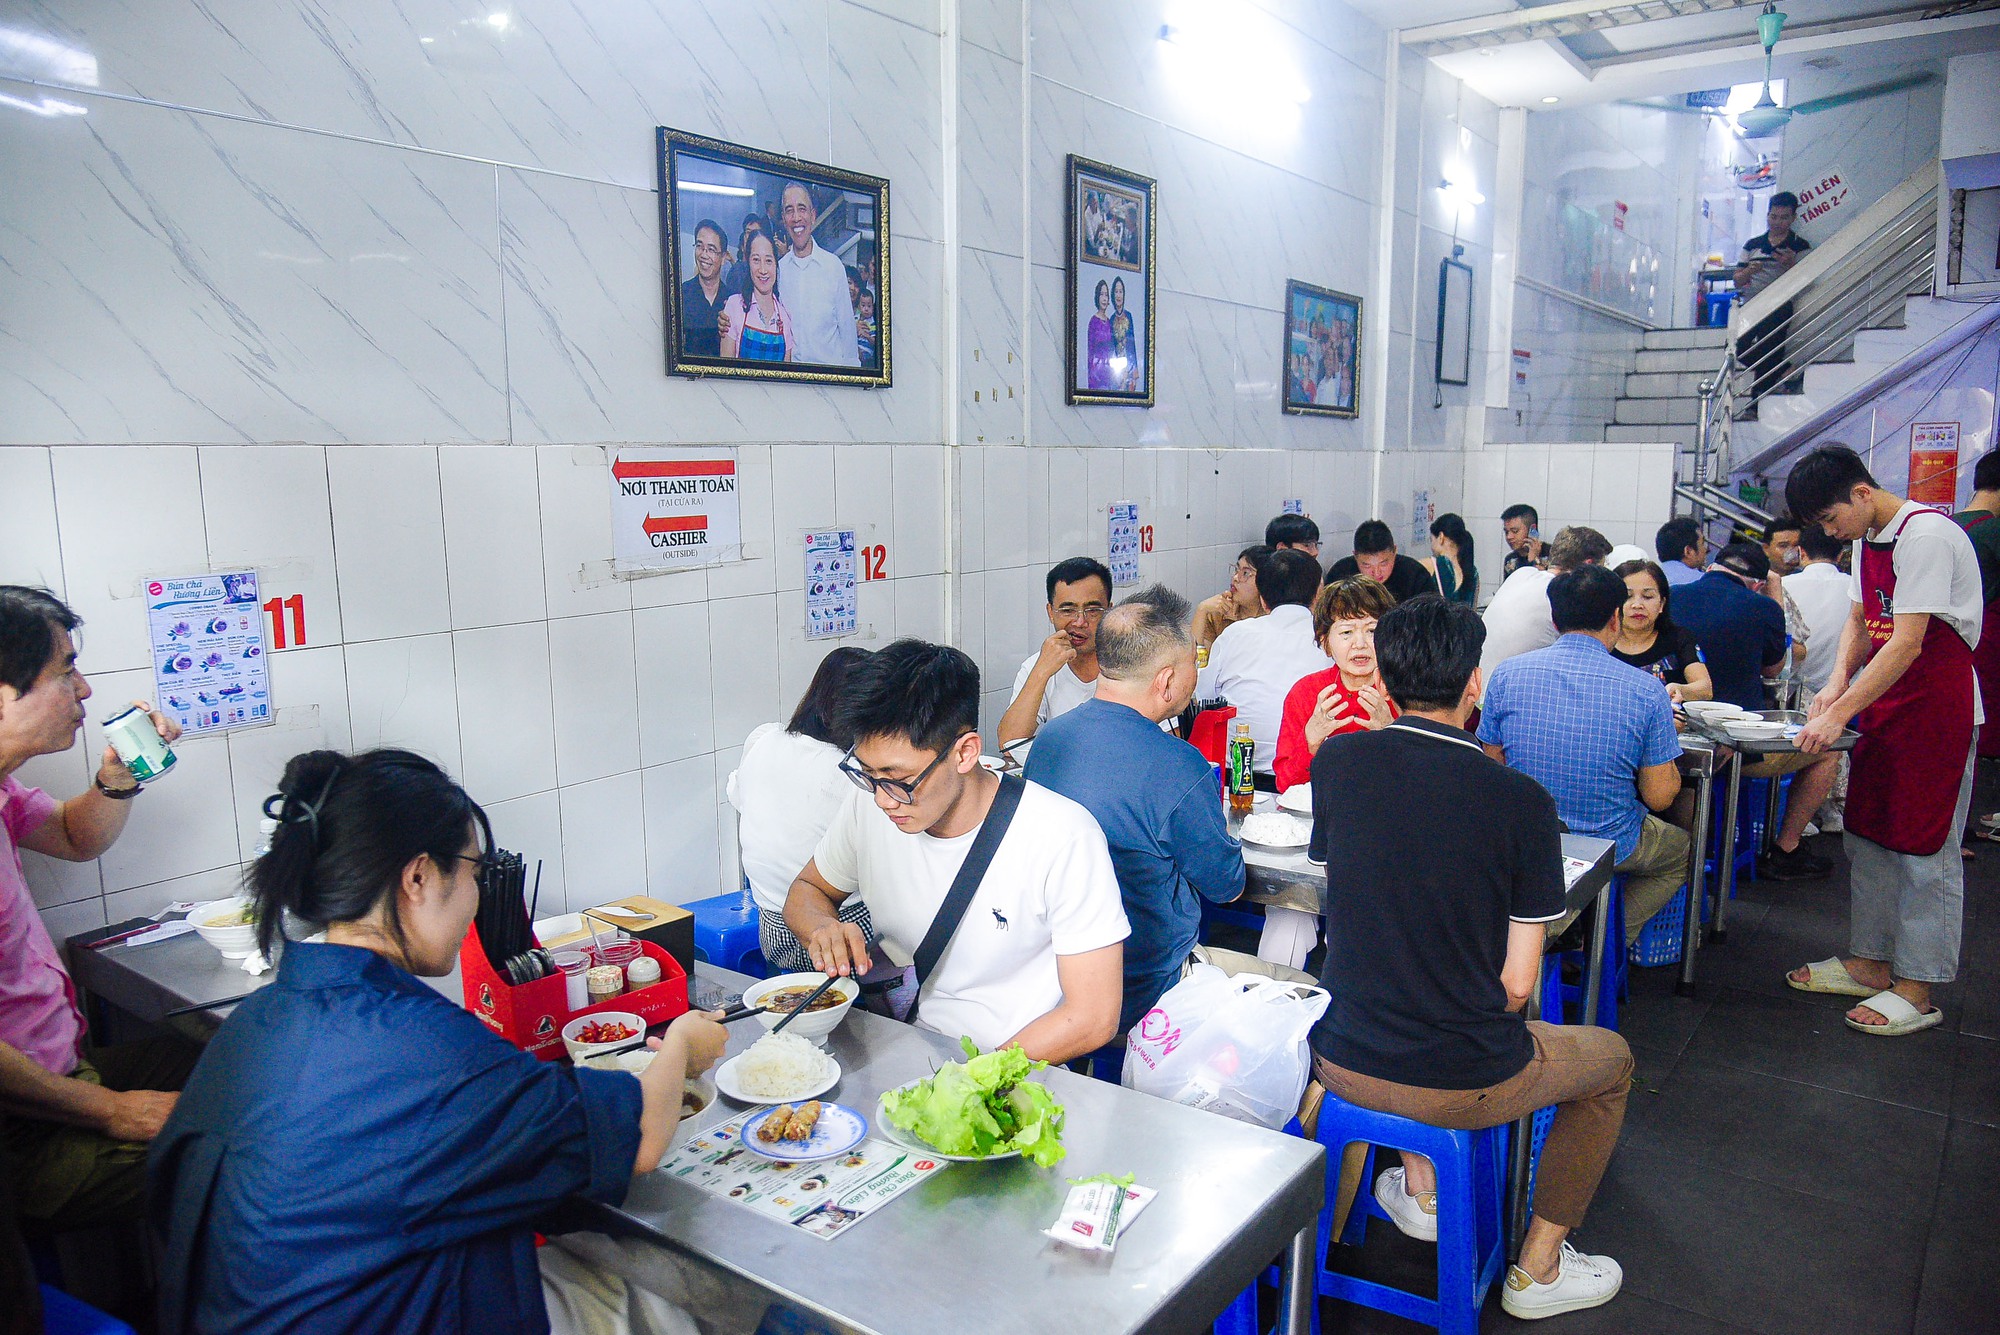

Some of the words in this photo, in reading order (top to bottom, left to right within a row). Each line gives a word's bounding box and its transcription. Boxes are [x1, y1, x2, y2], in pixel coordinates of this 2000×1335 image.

[1830, 196, 1840, 206] 2
[621, 480, 647, 496] NƠI
[650, 480, 697, 495] THANH
[699, 476, 735, 493] TOÁN
[691, 498, 704, 506] RA)
[651, 531, 708, 548] CASHIER
[1139, 525, 1154, 553] 13
[662, 550, 698, 560] (OUTSIDE)
[861, 544, 886, 581] 12
[263, 593, 306, 650] 11
